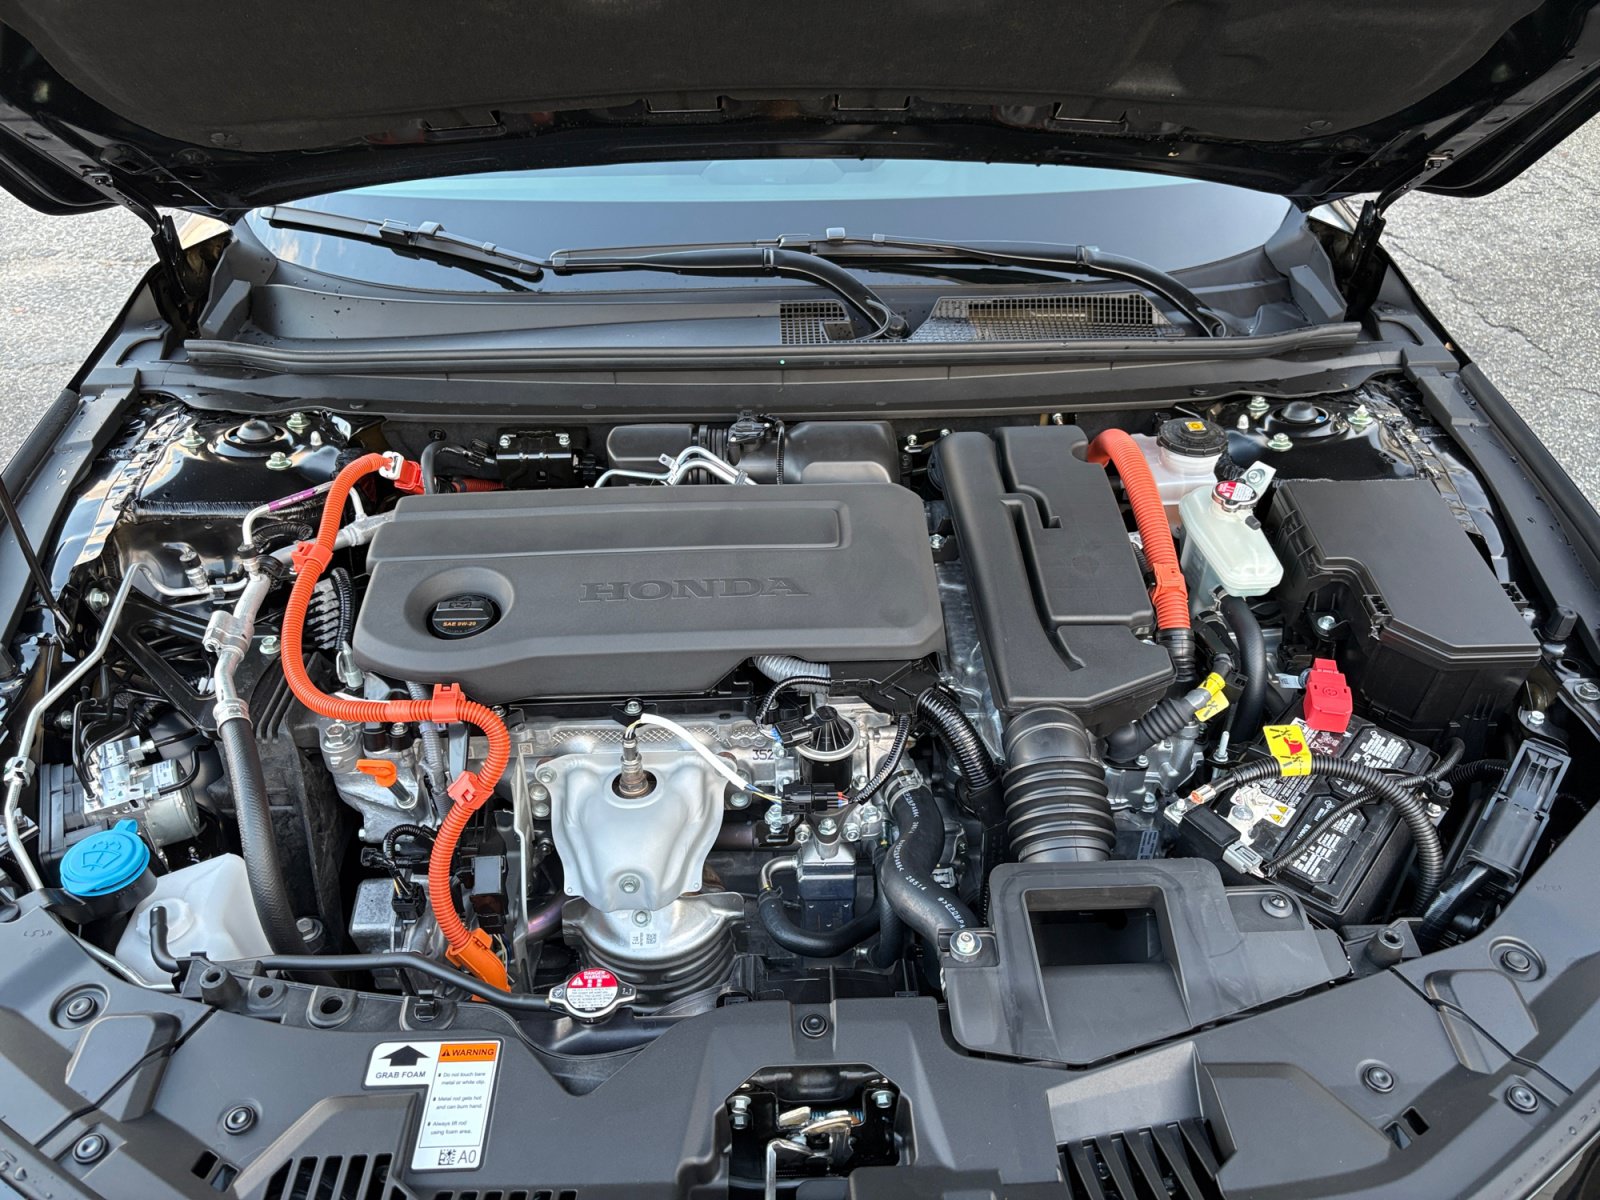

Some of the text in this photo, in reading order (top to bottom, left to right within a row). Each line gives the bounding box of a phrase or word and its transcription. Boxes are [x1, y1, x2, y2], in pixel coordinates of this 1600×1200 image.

[578, 576, 811, 603] HONDA
[752, 749, 774, 760] 352
[451, 1048, 495, 1056] WARNING
[375, 1070, 427, 1079] GRAB FOAM
